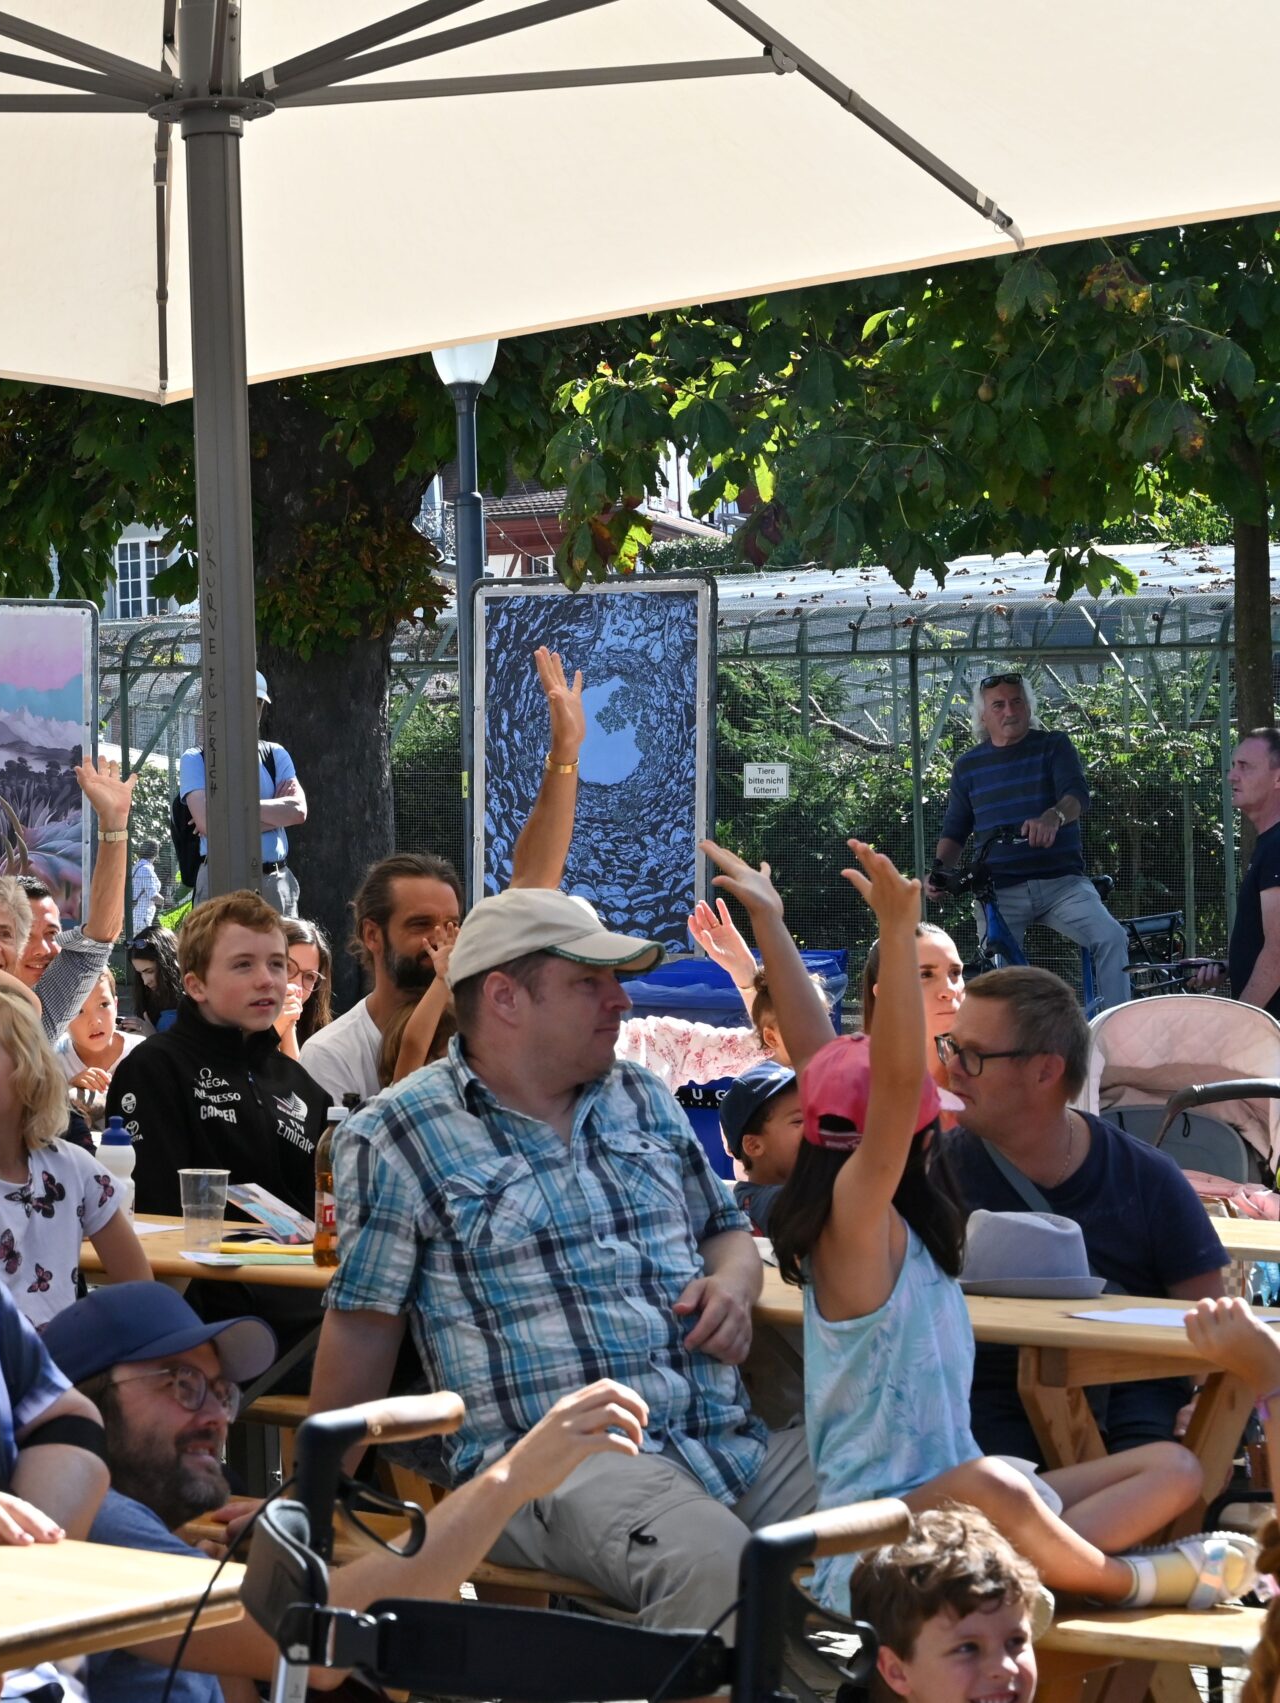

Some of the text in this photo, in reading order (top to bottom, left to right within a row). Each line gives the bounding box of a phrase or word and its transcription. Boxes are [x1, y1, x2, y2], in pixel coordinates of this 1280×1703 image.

[757, 767, 776, 775] Tiere
[748, 777, 784, 785] bitte nicht
[753, 786, 780, 794] füttern!
[276, 1119, 316, 1154] Emirate
